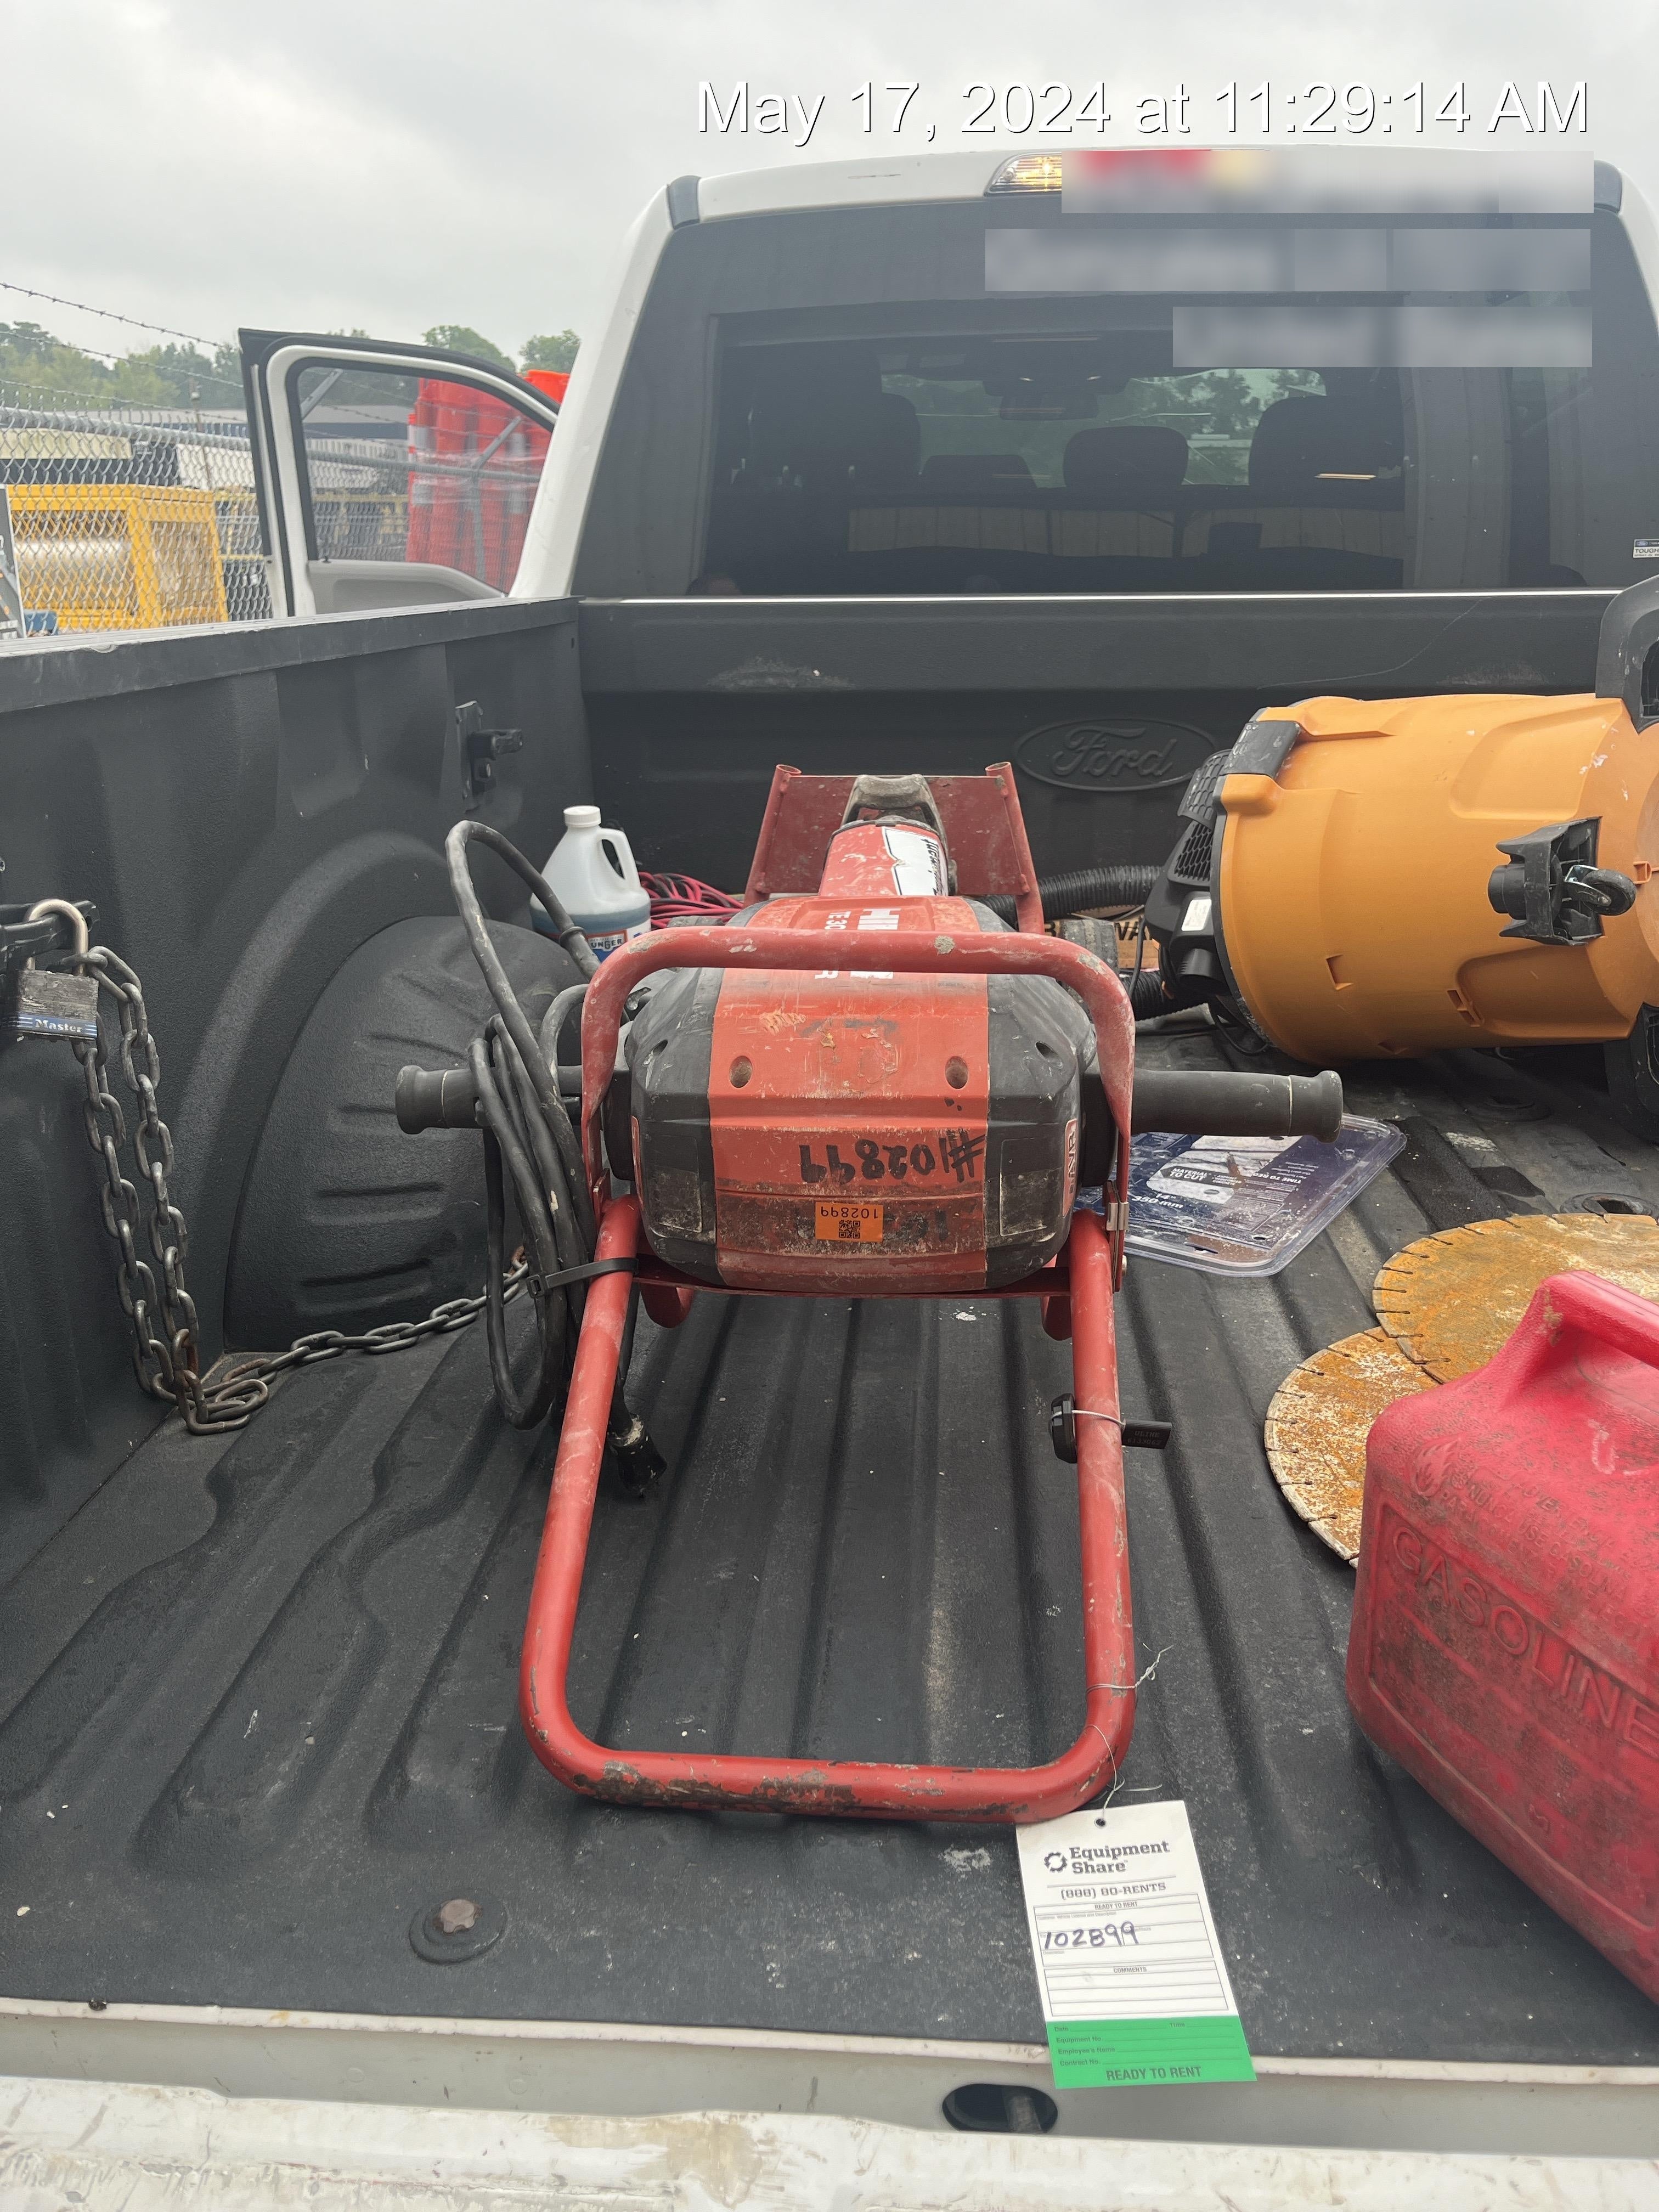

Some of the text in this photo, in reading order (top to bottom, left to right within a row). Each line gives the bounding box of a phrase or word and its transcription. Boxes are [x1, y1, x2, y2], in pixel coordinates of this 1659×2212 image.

[1052, 726, 1177, 777] Ford
[590, 939, 622, 949] UNGER
[35, 1019, 82, 1033] Master
[799, 1128, 986, 1184] #102899
[1172, 1167, 1207, 1177] MATERIAL
[1131, 1195, 1184, 1209] 350 mm
[820, 1206, 878, 1219] 102899
[1392, 1526, 1659, 1756] GASOLINE
[1069, 1839, 1171, 1861] Equipment
[1071, 1861, 1126, 1875] Share
[1058, 2047, 1096, 2055] Employee's
[1106, 2066, 1201, 2081] READY TO RENT
